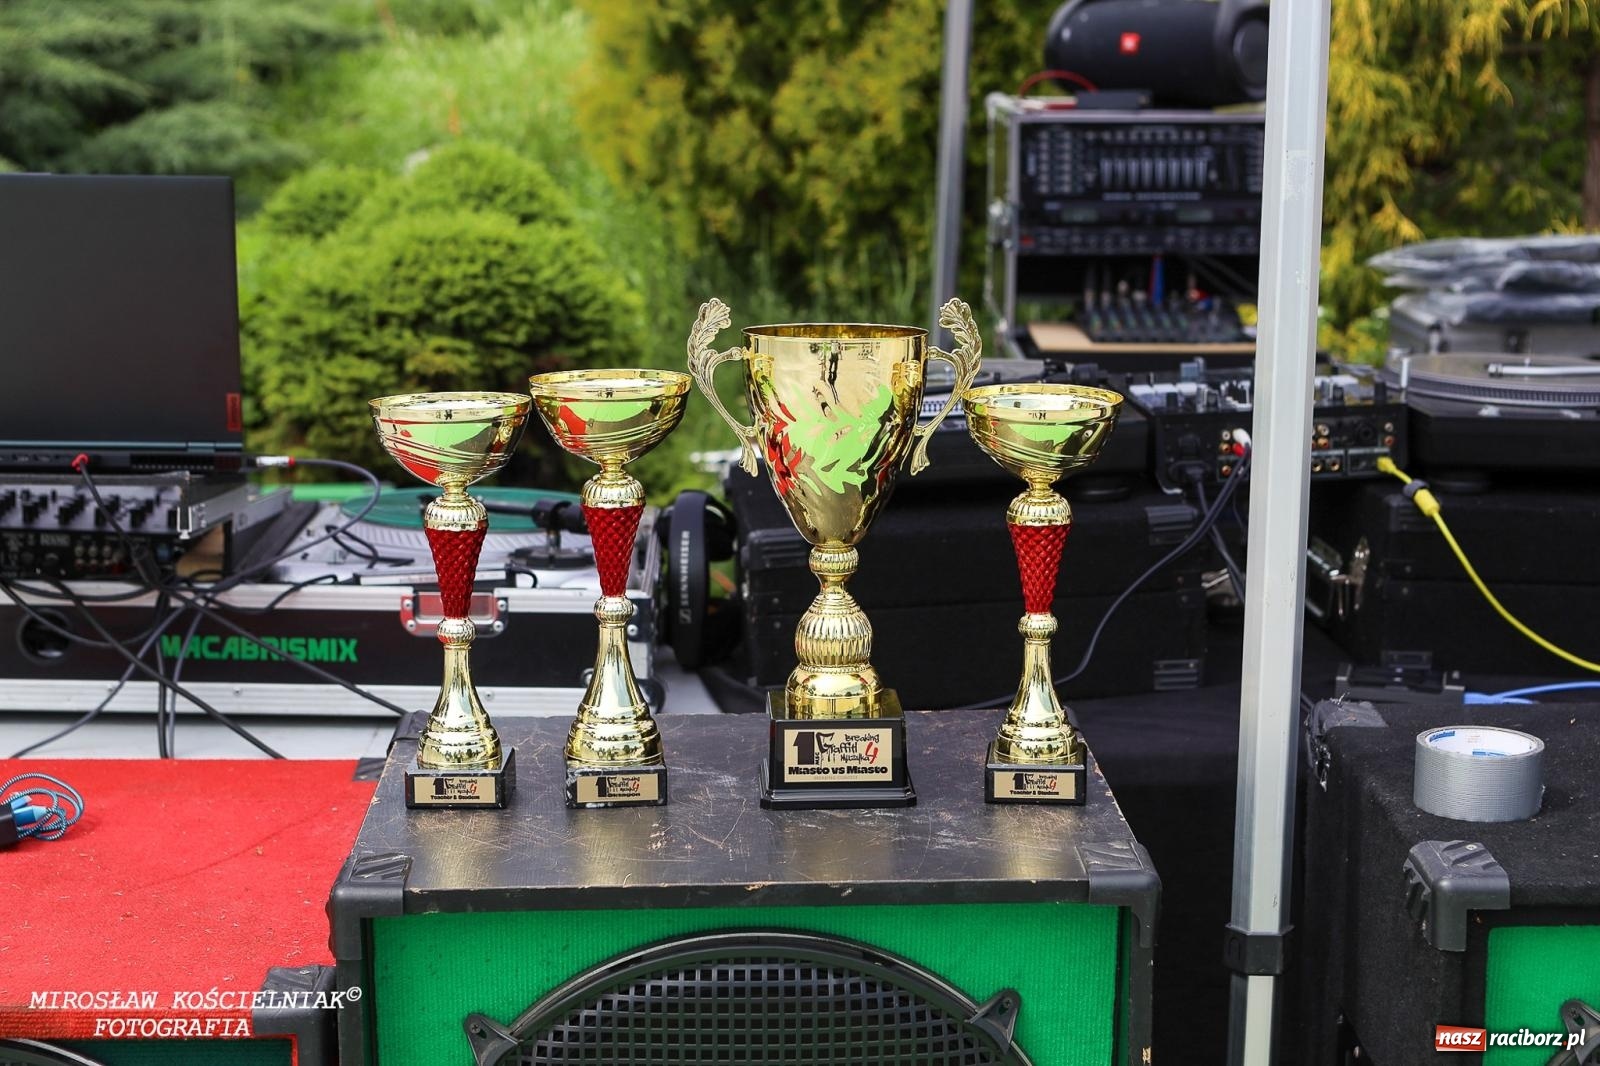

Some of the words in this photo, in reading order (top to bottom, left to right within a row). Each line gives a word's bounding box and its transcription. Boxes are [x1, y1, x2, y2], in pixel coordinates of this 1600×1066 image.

[160, 635, 358, 662] MACABRISMIX
[793, 731, 815, 765] 1
[865, 741, 879, 764] 4
[788, 766, 830, 775] Miasto
[832, 766, 845, 774] vs
[846, 765, 888, 774] Miasto
